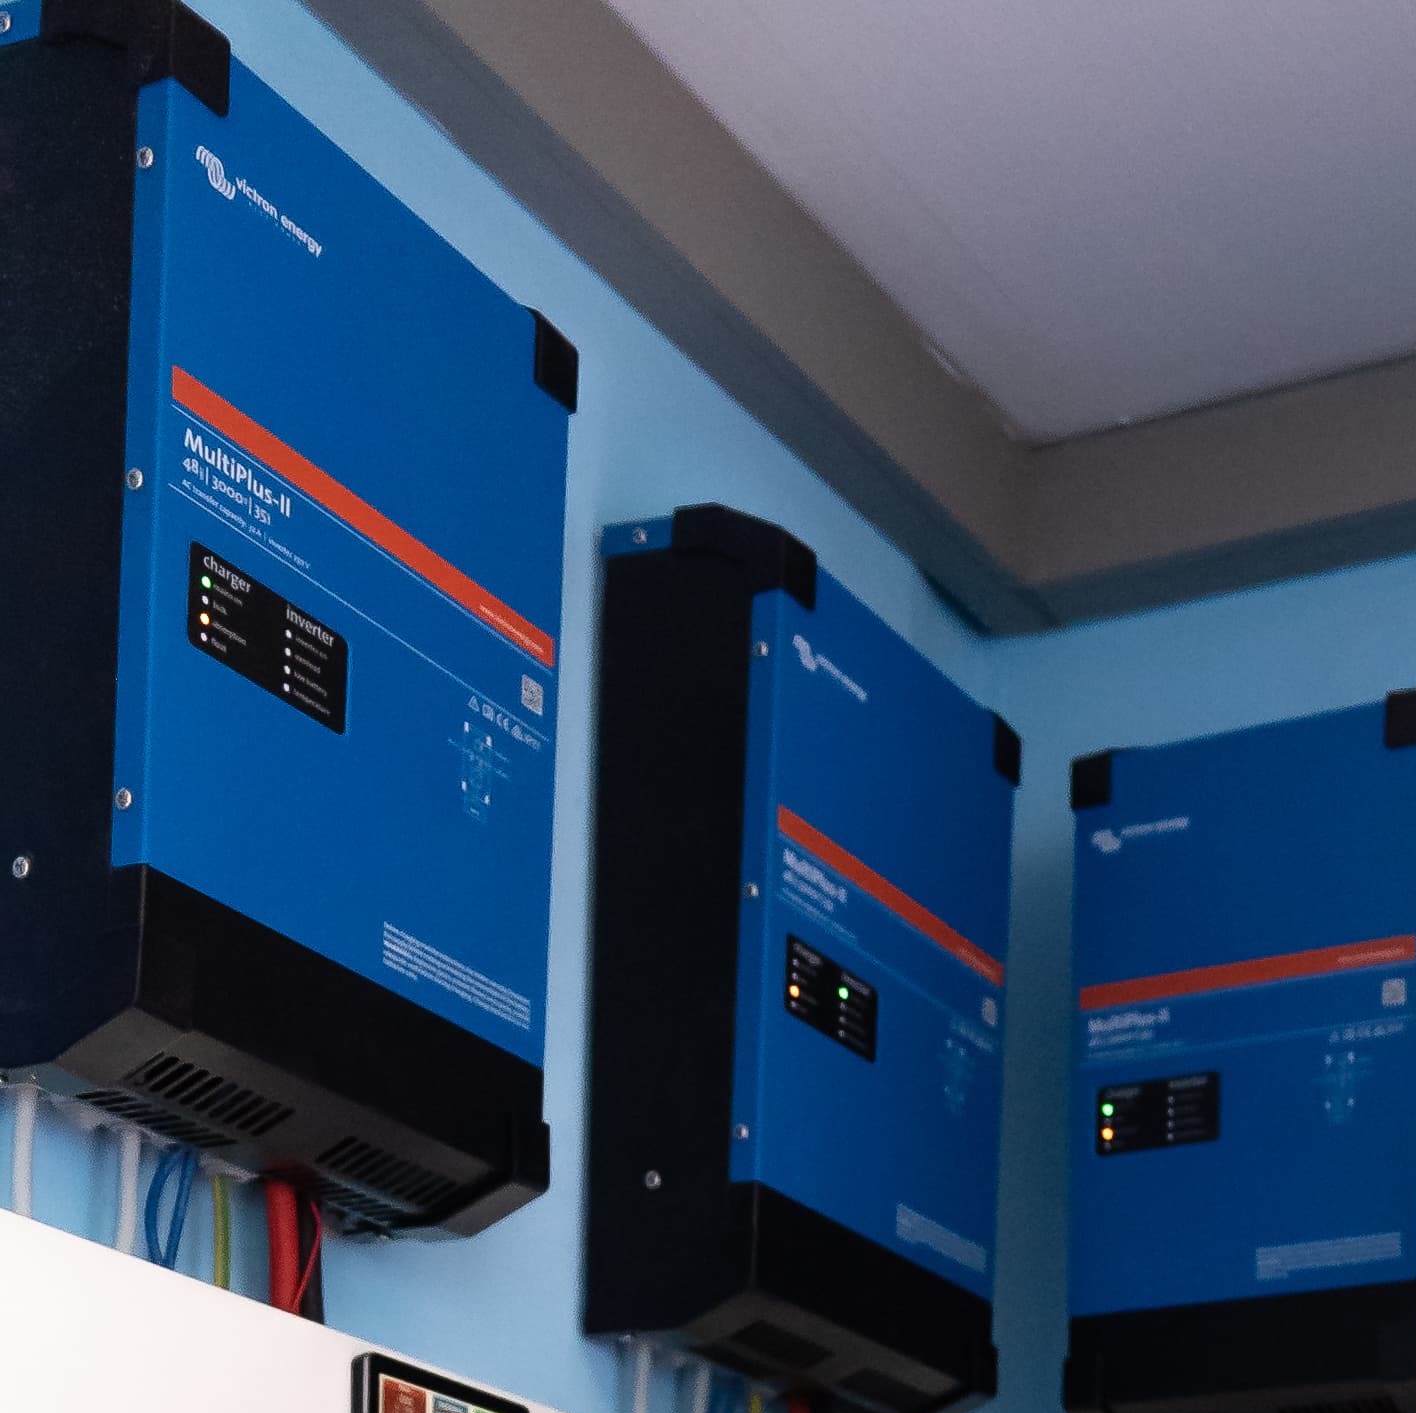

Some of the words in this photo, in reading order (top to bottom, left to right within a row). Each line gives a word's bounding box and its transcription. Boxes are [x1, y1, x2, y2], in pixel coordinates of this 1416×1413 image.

[236, 177, 278, 220] victron
[280, 215, 322, 258] energy
[184, 428, 291, 518] MultiPlus-II
[203, 556, 252, 594] charger
[286, 603, 335, 647] inverter
